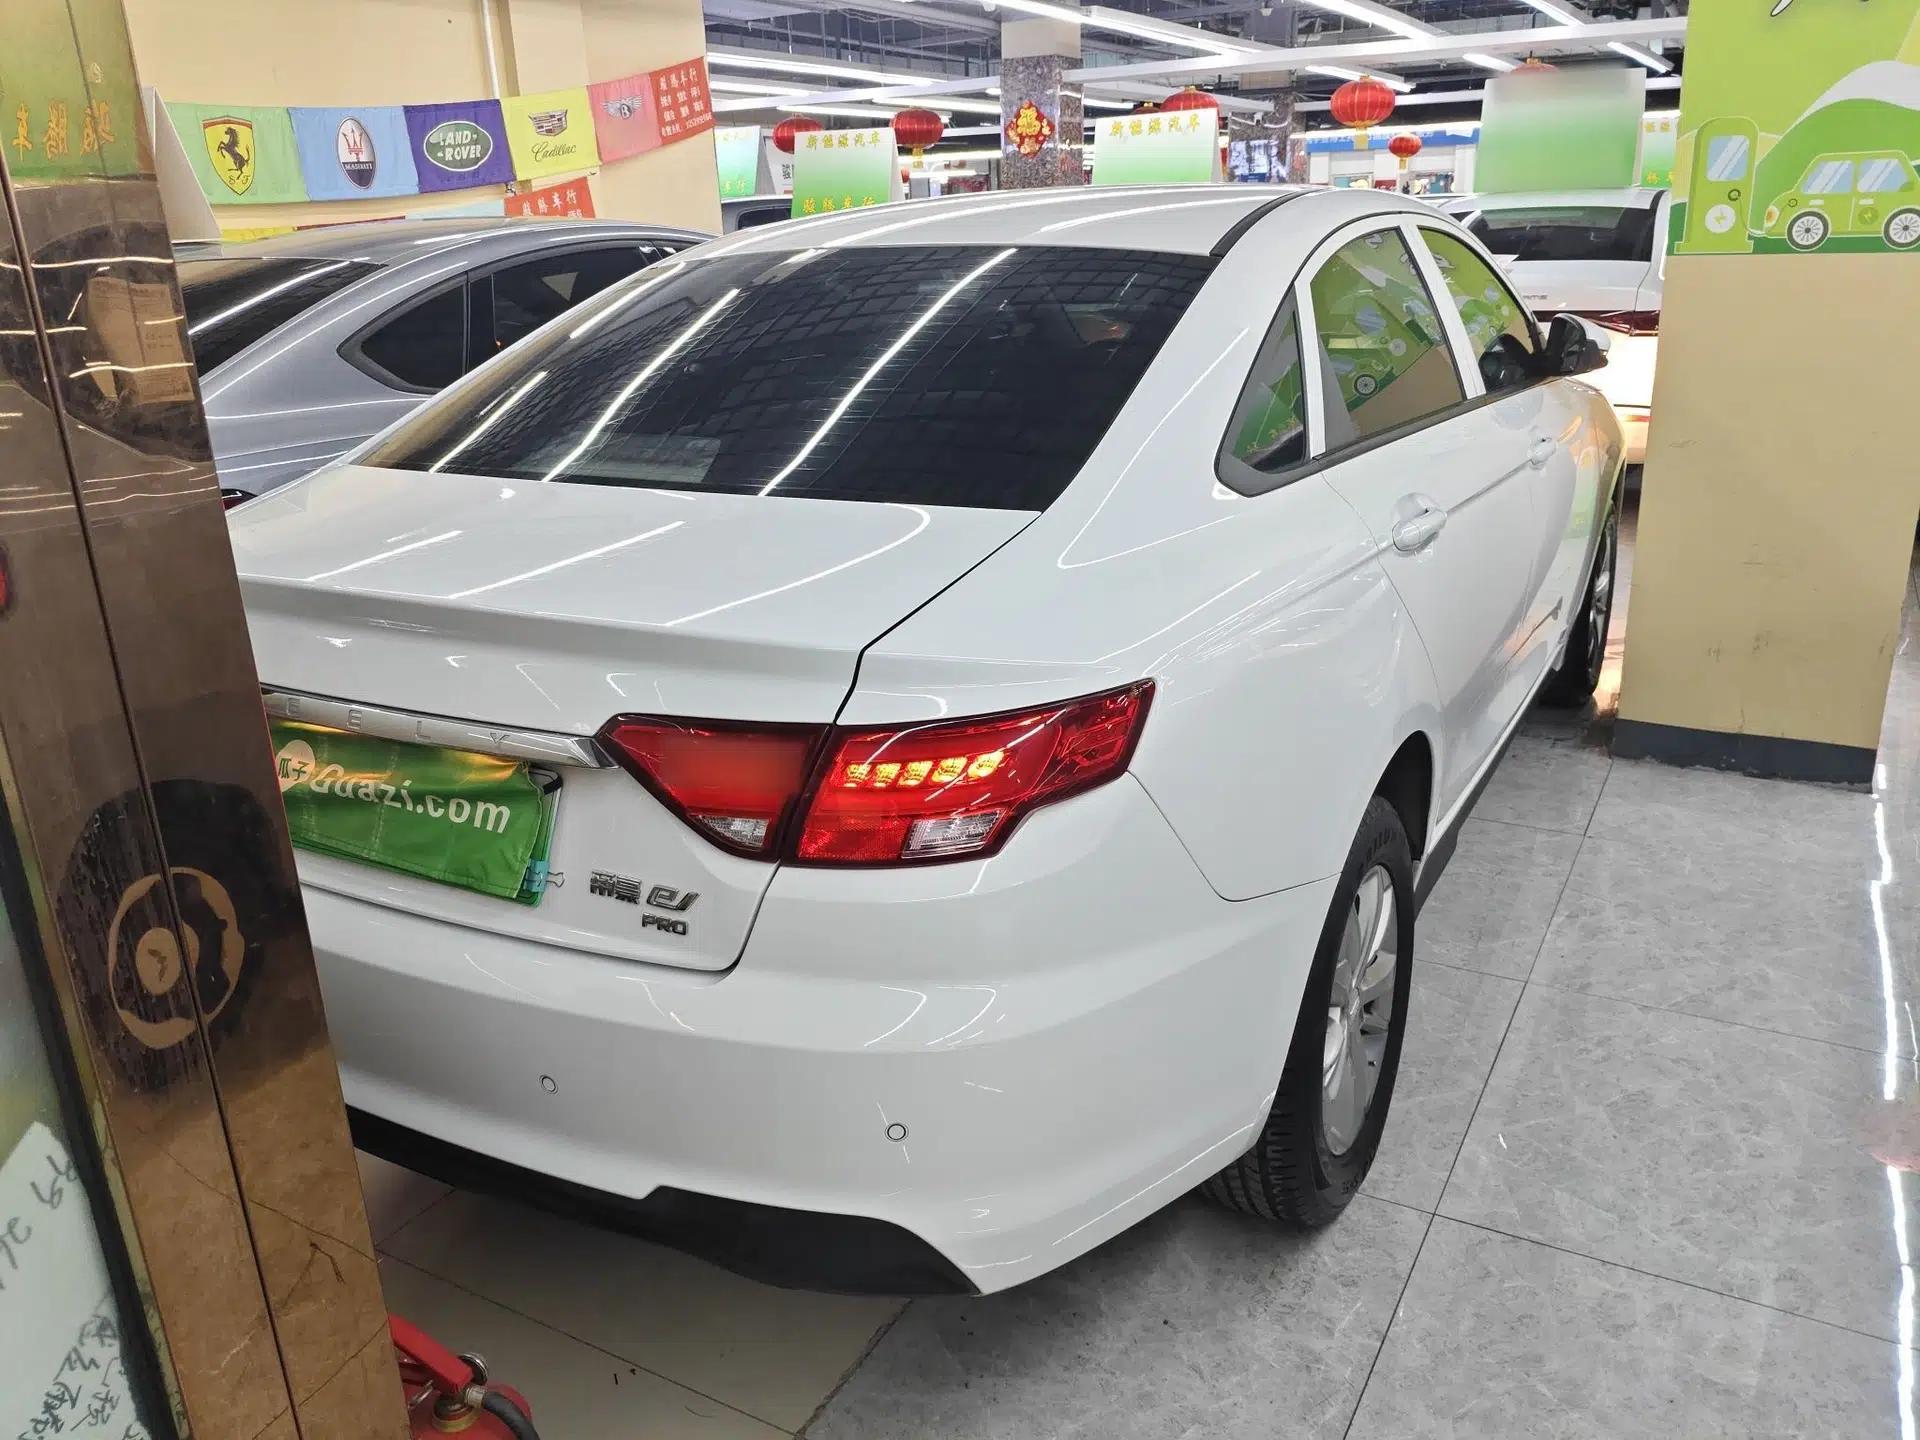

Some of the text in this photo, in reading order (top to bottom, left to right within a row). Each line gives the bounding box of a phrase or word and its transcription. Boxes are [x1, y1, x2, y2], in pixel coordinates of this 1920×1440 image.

[439, 130, 472, 146] LAND
[445, 144, 482, 162] ROVER
[531, 141, 577, 163] Cadillac
[278, 759, 307, 780] 瓜子
[309, 763, 512, 834] Guazi.com
[641, 911, 687, 936] PRO
